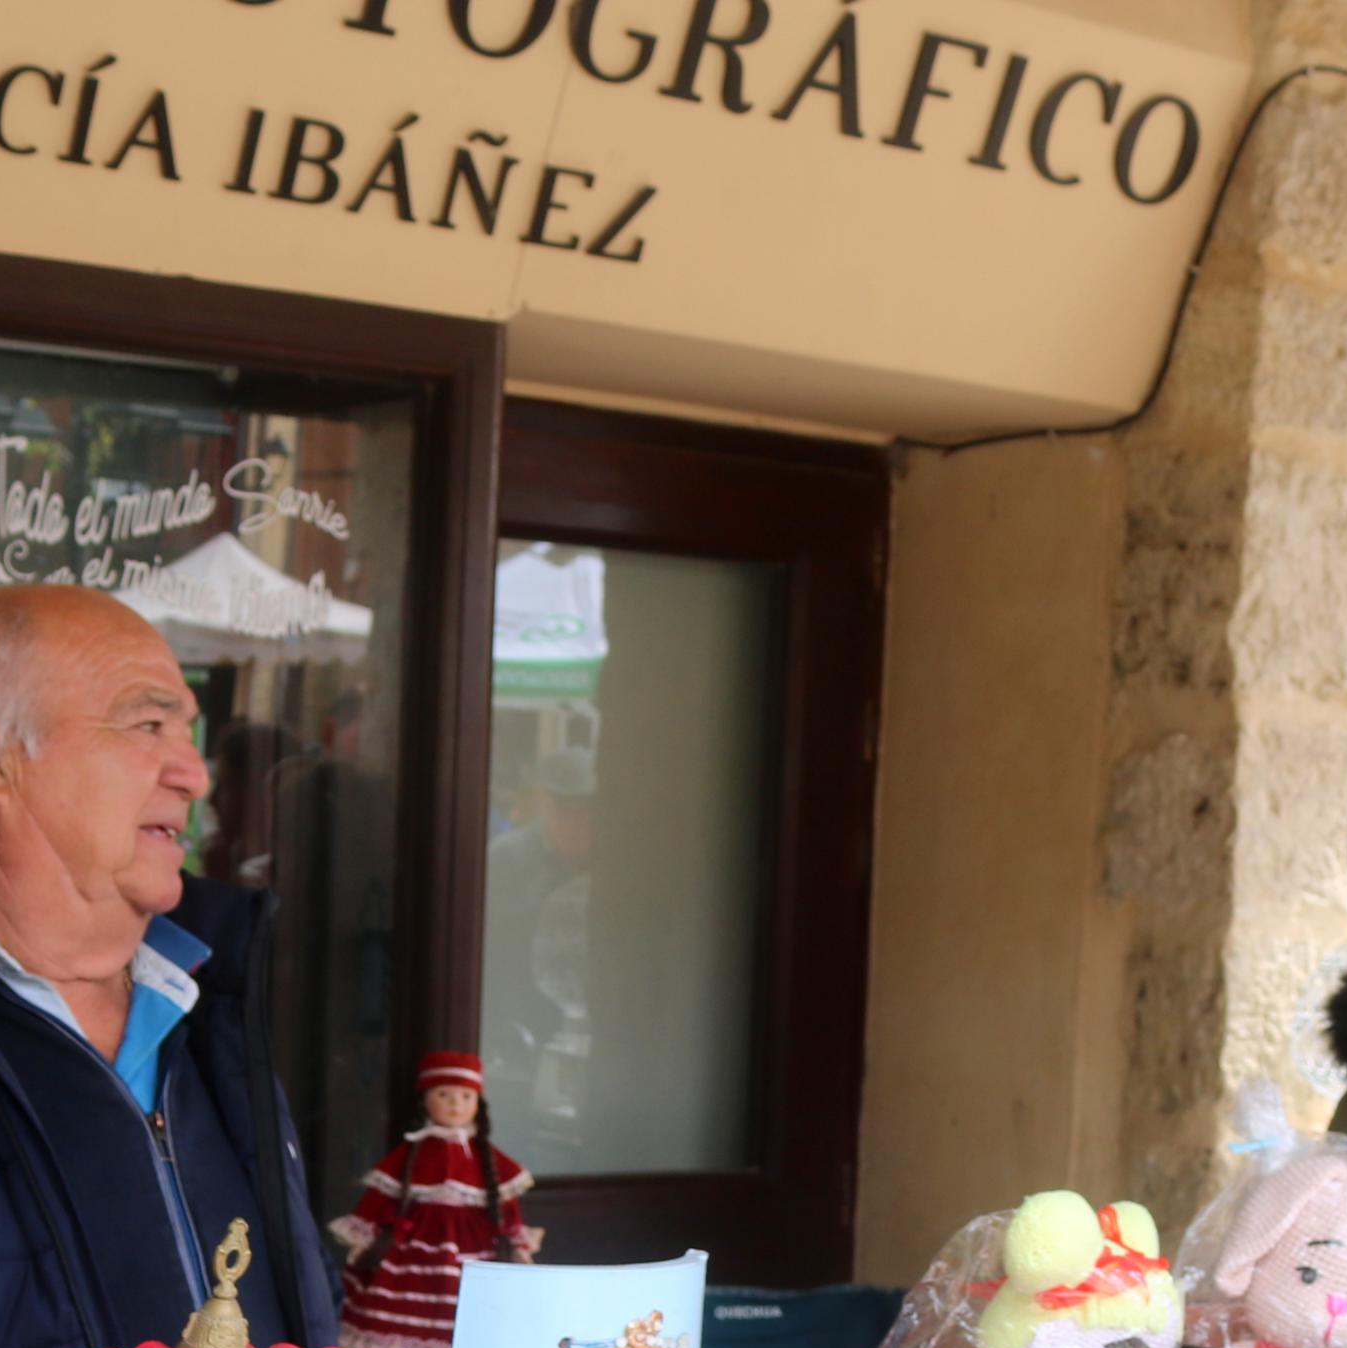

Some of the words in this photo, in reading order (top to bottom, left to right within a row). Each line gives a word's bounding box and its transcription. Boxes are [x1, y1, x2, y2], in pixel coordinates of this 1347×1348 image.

[222, 106, 658, 263] IBÁÑEZ
[74, 476, 110, 546] el
[110, 468, 217, 542] mundo
